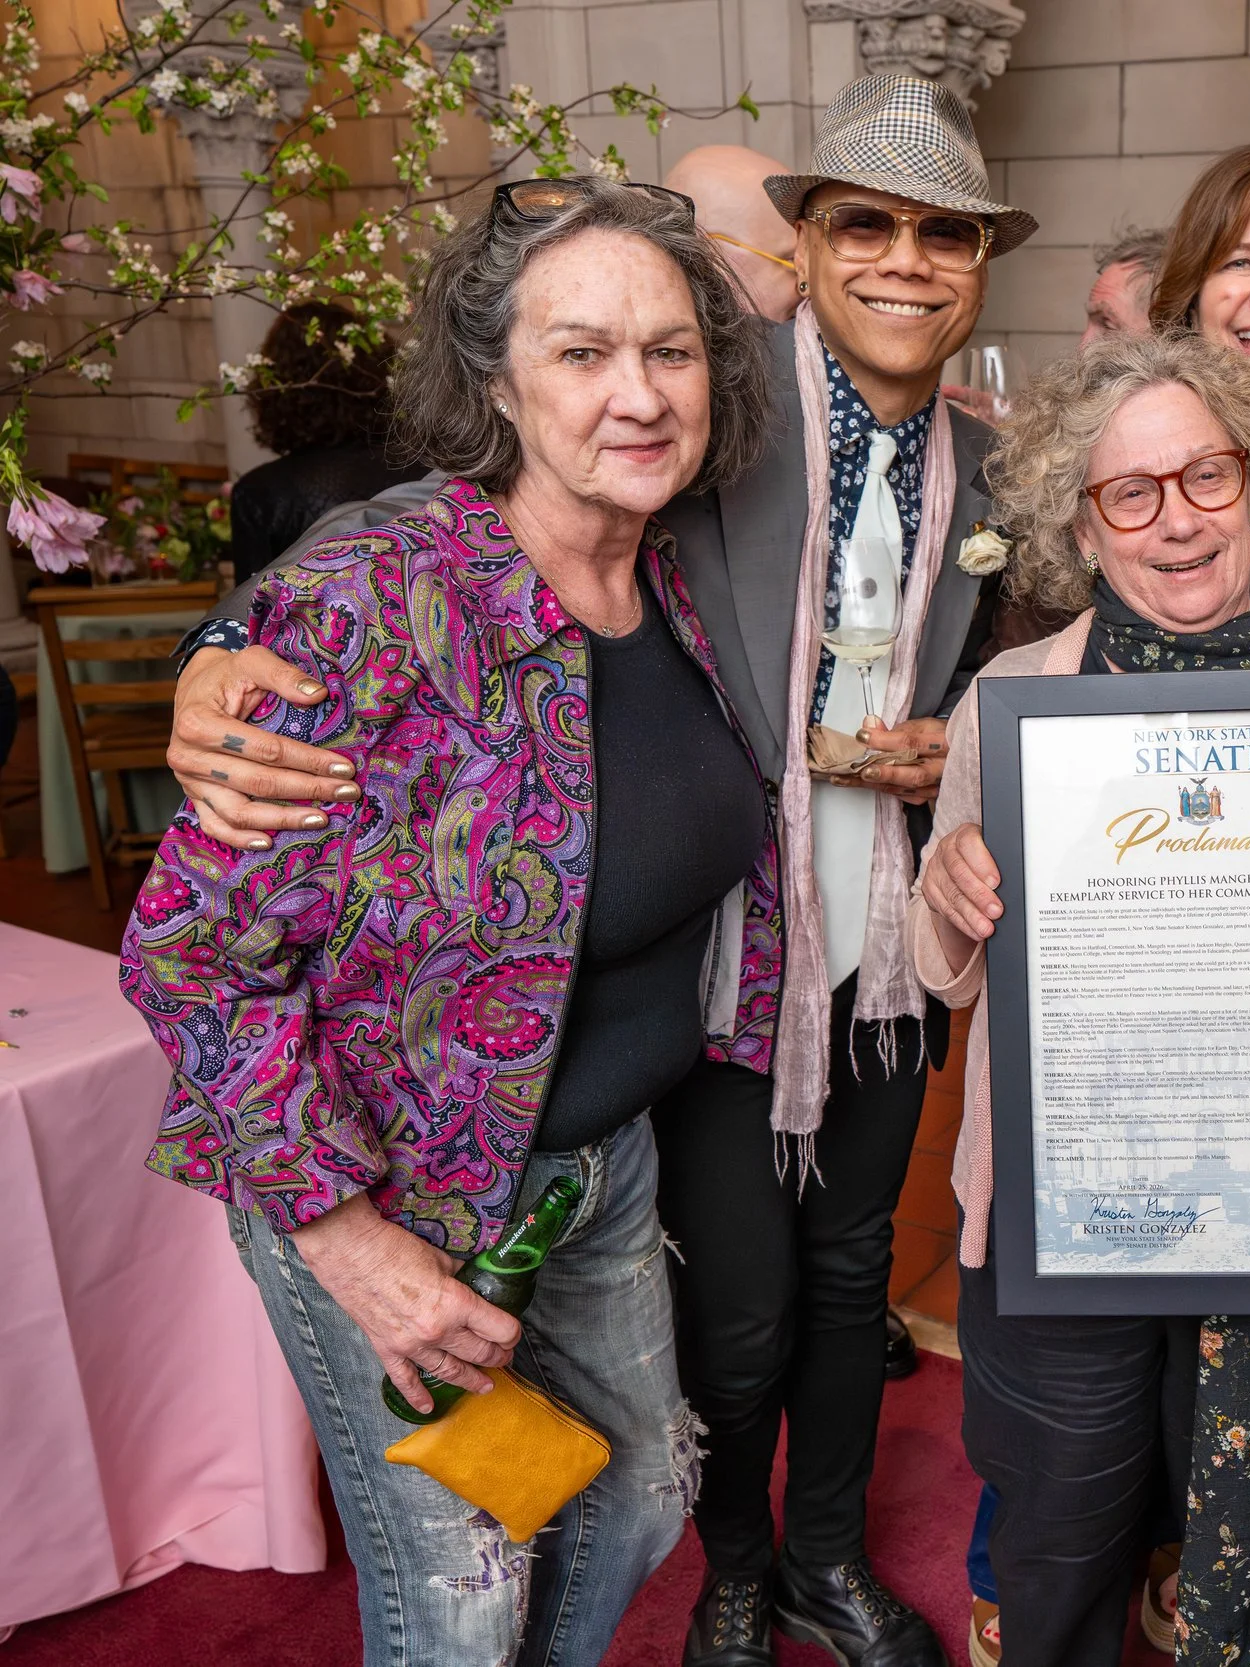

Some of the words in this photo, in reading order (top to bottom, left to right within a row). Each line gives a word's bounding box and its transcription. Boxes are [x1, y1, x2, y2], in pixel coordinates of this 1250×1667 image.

[1134, 731, 1169, 743] NEW
[1174, 728, 1217, 741] YORK
[1087, 877, 1156, 888] HONORING
[1160, 875, 1206, 886] PHYLLIS
[1050, 891, 1115, 903] EXEMPLARY
[1118, 890, 1165, 900] SERVICE
[1168, 889, 1185, 899] TO
[1189, 889, 1213, 899] HER
[1090, 1196, 1135, 1221] Kristen
[1083, 1223, 1135, 1234] KRISTEN
[1140, 1223, 1206, 1234] GONZALEZ
[498, 1224, 526, 1258] Heineken
